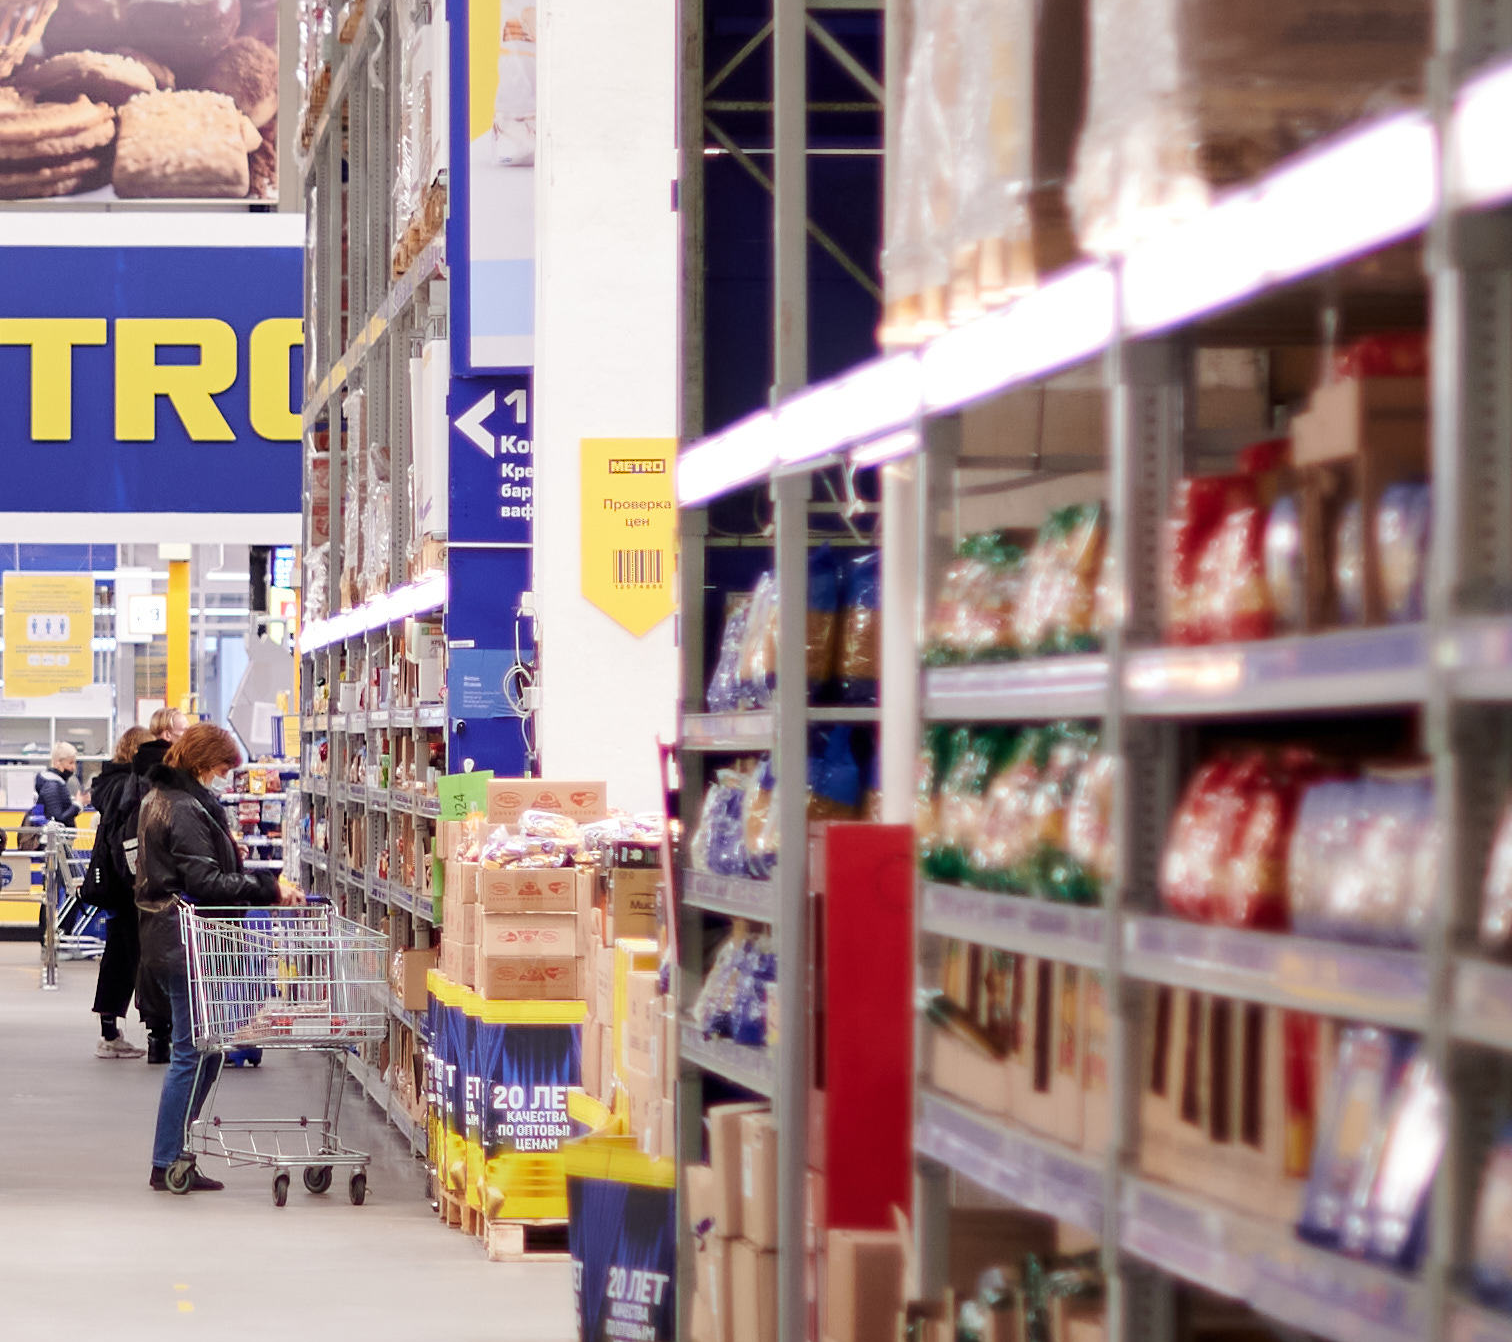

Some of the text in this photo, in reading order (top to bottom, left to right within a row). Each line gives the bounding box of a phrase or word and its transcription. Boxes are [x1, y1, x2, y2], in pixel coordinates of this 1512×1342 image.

[501, 435, 534, 454] Ко
[611, 460, 663, 472] METRO
[501, 483, 534, 501] бар
[603, 498, 672, 512] Проверка
[625, 517, 650, 528] цен
[493, 1085, 525, 1109] 20
[506, 1110, 568, 1123] КАЧЕСТВА
[498, 1124, 514, 1136] ПО
[515, 1138, 558, 1151] ЦЕНАМ
[606, 1266, 670, 1305] 20 ЛЕТ
